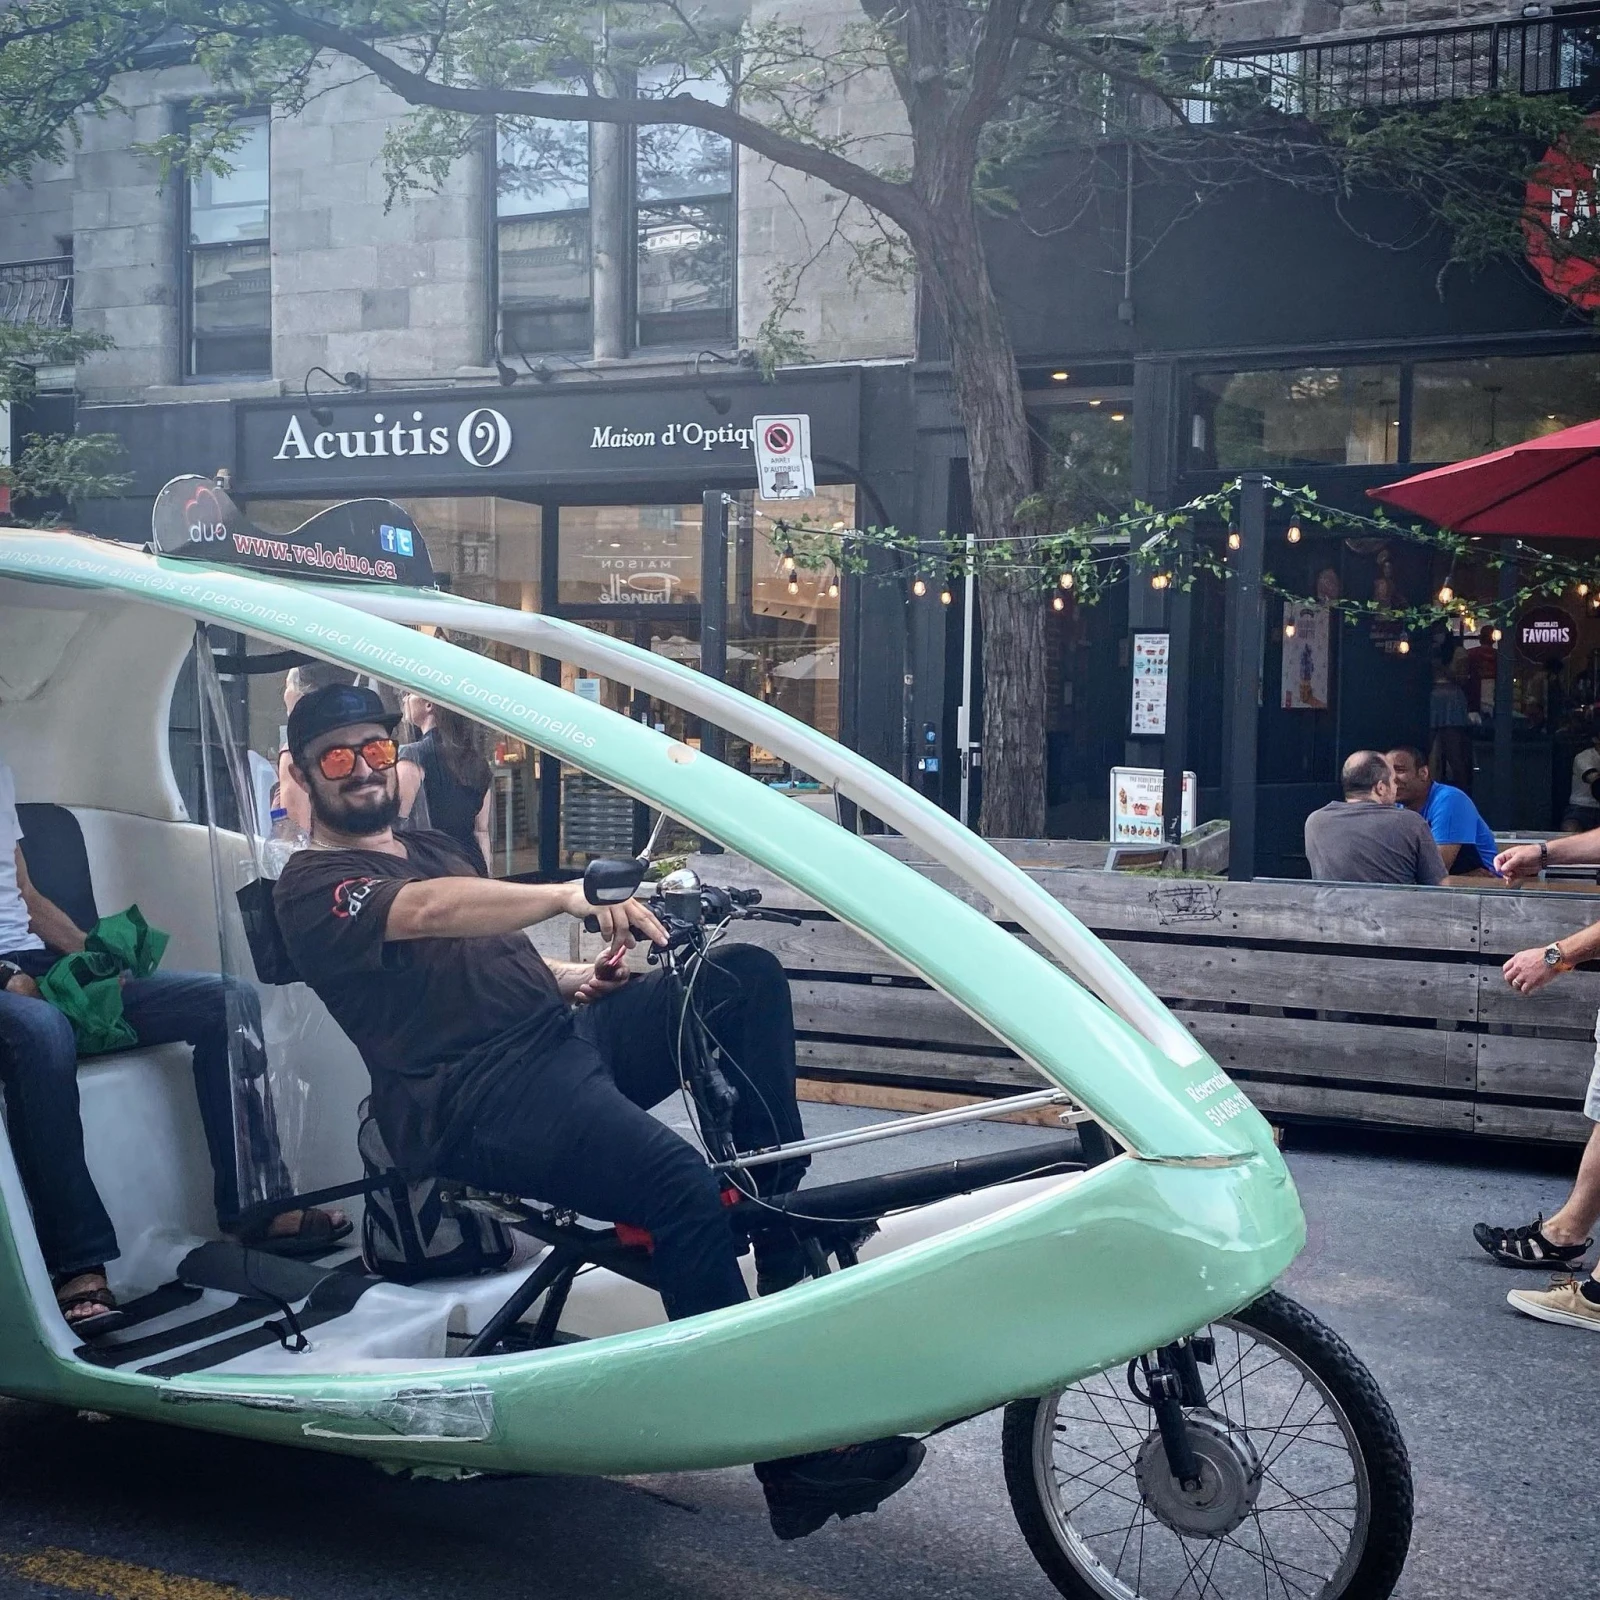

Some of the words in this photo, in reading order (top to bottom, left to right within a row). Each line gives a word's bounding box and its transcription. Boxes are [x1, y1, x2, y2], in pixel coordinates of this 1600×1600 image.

[1551, 188, 1600, 239] FA
[273, 411, 449, 460] Acuitis
[590, 425, 656, 448] Maison
[188, 521, 227, 543] duo
[232, 533, 397, 579] www.veloduo.ca
[0, 549, 65, 567] ansport
[64, 558, 108, 574] pour
[180, 582, 201, 597] et
[199, 590, 298, 627] personnes
[305, 622, 350, 646] avec
[352, 636, 454, 685] limitations
[456, 677, 596, 748] fonctionnelles
[1522, 627, 1570, 643] FAVORIS
[1204, 1105, 1229, 1128] 514
